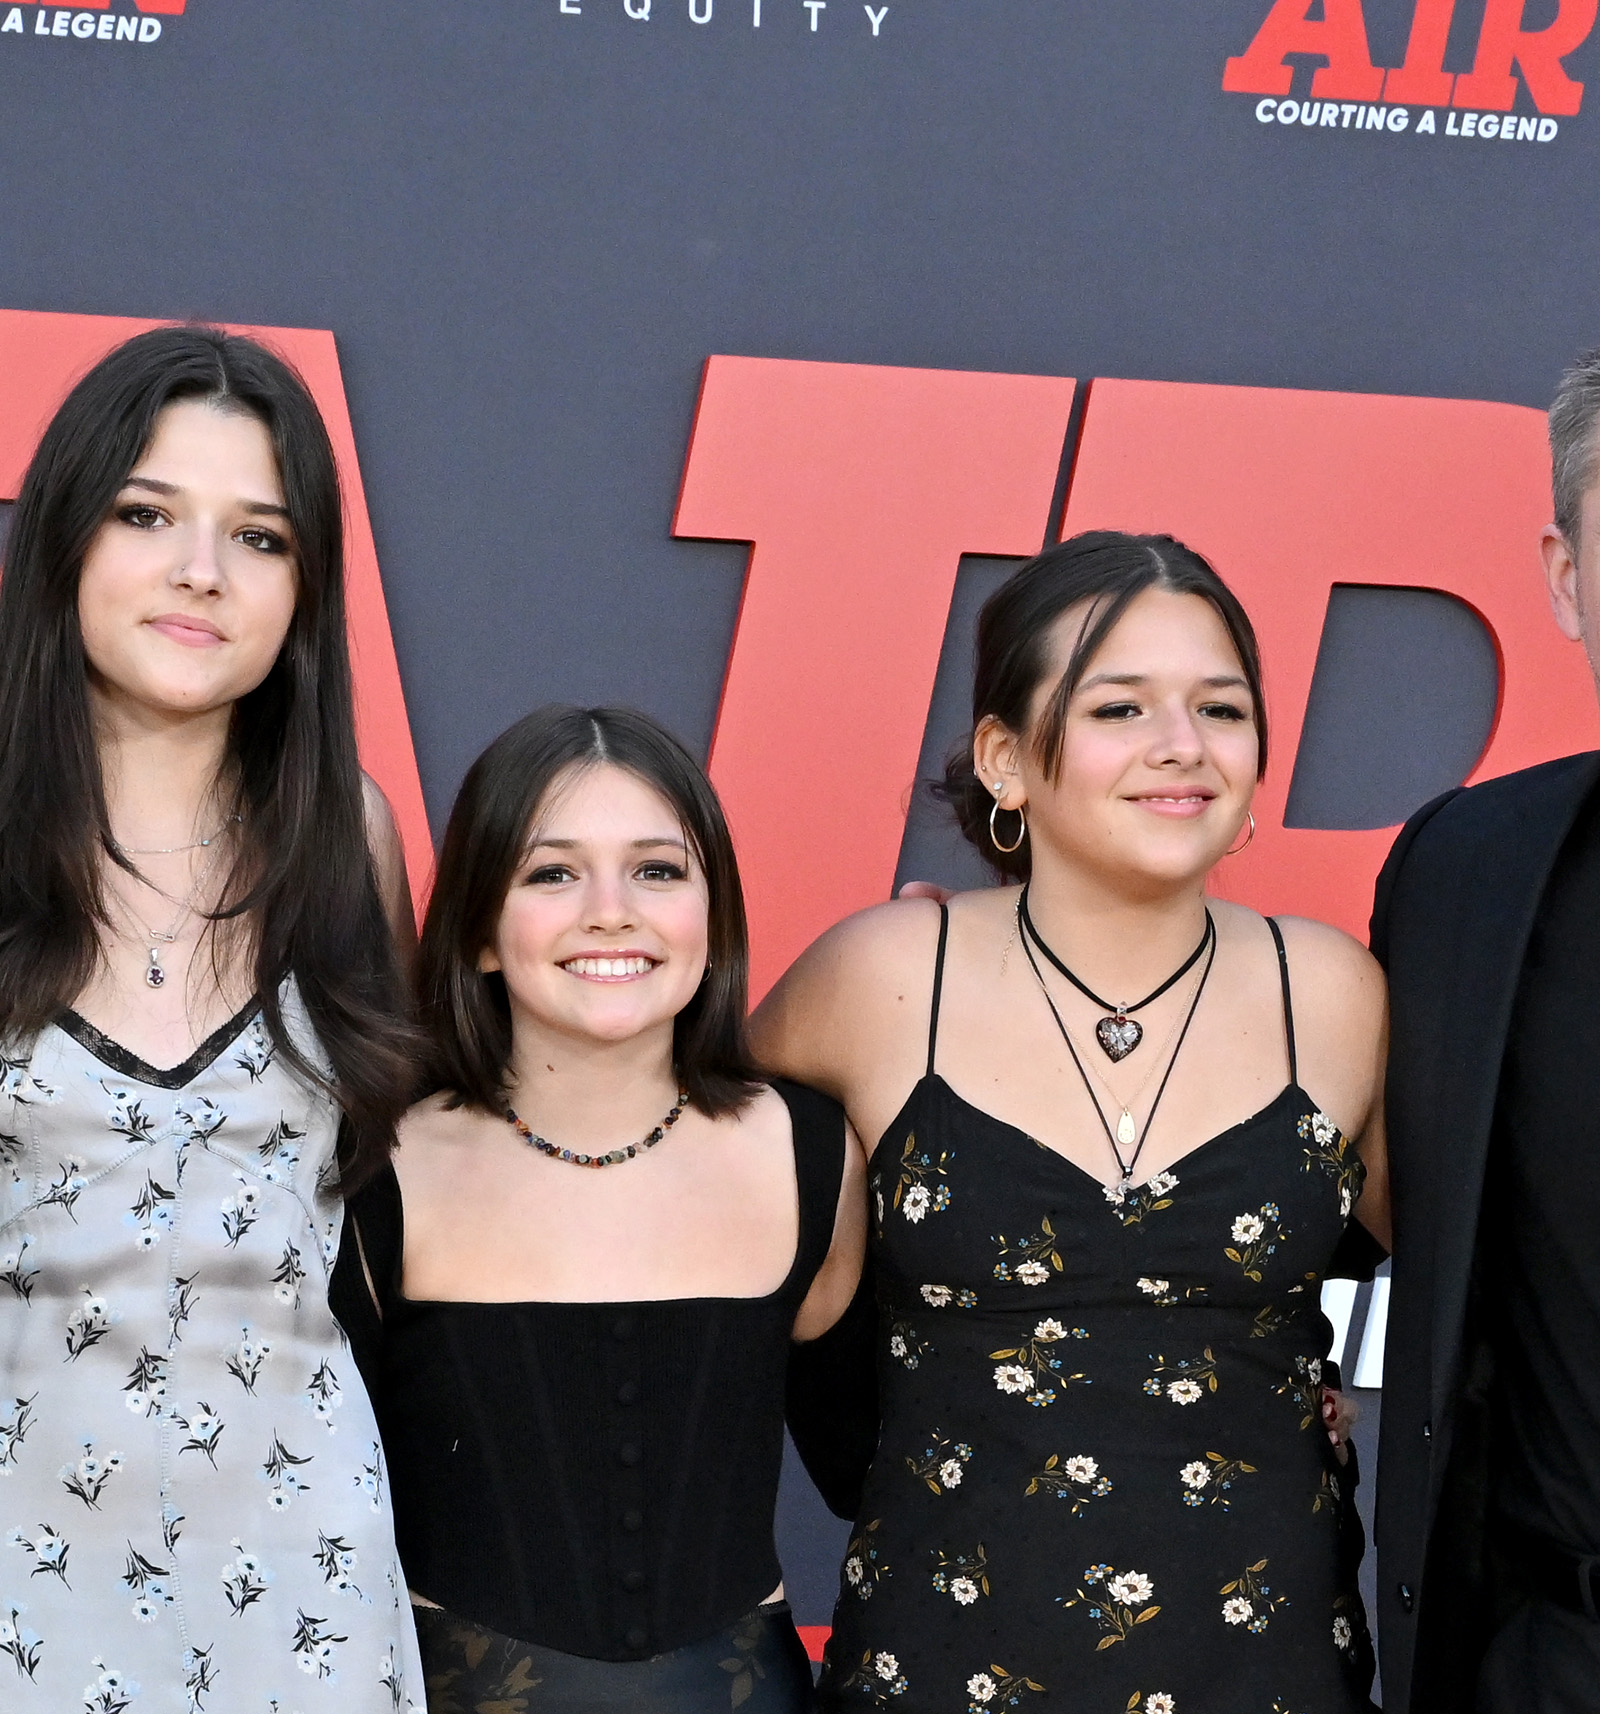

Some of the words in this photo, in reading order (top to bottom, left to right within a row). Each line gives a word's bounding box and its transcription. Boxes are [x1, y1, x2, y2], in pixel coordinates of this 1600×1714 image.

[1, 8, 23, 33] A
[35, 10, 161, 42] LEGEND
[1223, 0, 1598, 115] AIR
[1256, 99, 1409, 132] COURTING
[1416, 110, 1435, 134] A
[1445, 112, 1558, 142] LEGEND
